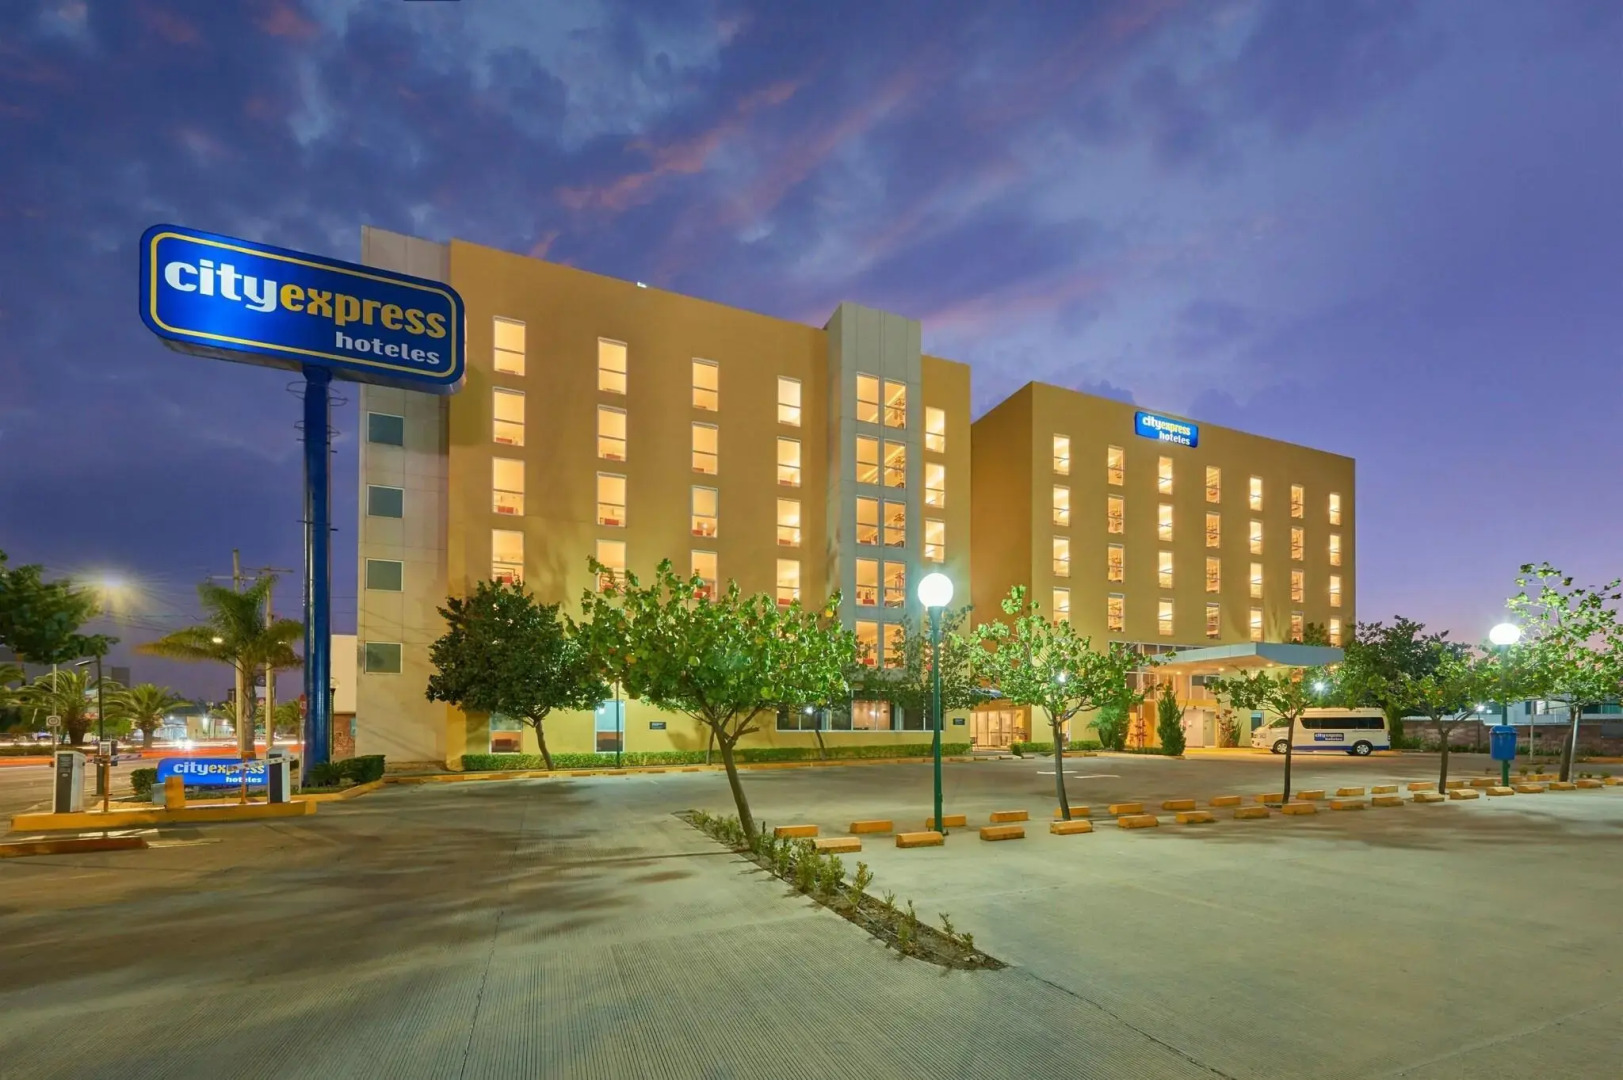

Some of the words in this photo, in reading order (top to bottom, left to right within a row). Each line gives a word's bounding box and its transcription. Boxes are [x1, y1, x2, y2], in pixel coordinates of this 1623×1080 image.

[165, 259, 447, 338] cityexpress
[335, 332, 440, 364] hoteles
[1159, 431, 1190, 445] hoteles
